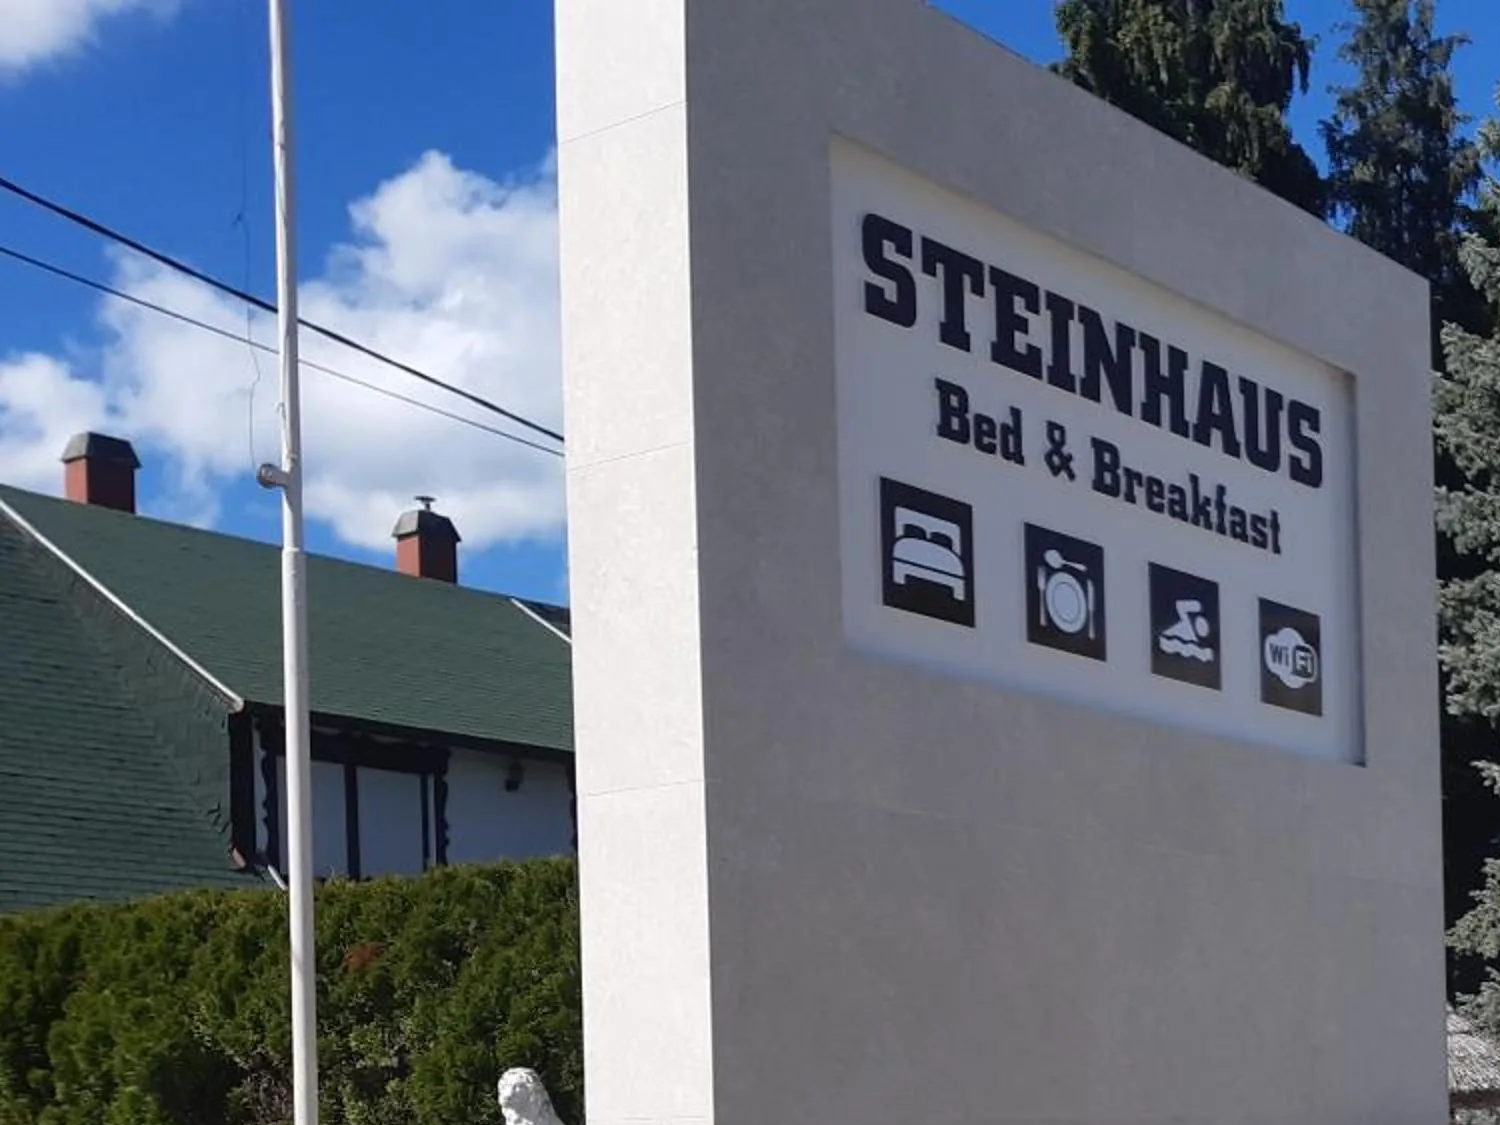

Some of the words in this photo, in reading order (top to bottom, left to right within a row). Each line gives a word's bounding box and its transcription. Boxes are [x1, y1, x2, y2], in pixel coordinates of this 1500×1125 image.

[861, 212, 1323, 489] STEINHAUS
[934, 377, 1025, 466] Bed
[1043, 419, 1076, 482] &
[1090, 436, 1282, 555] Breakfast
